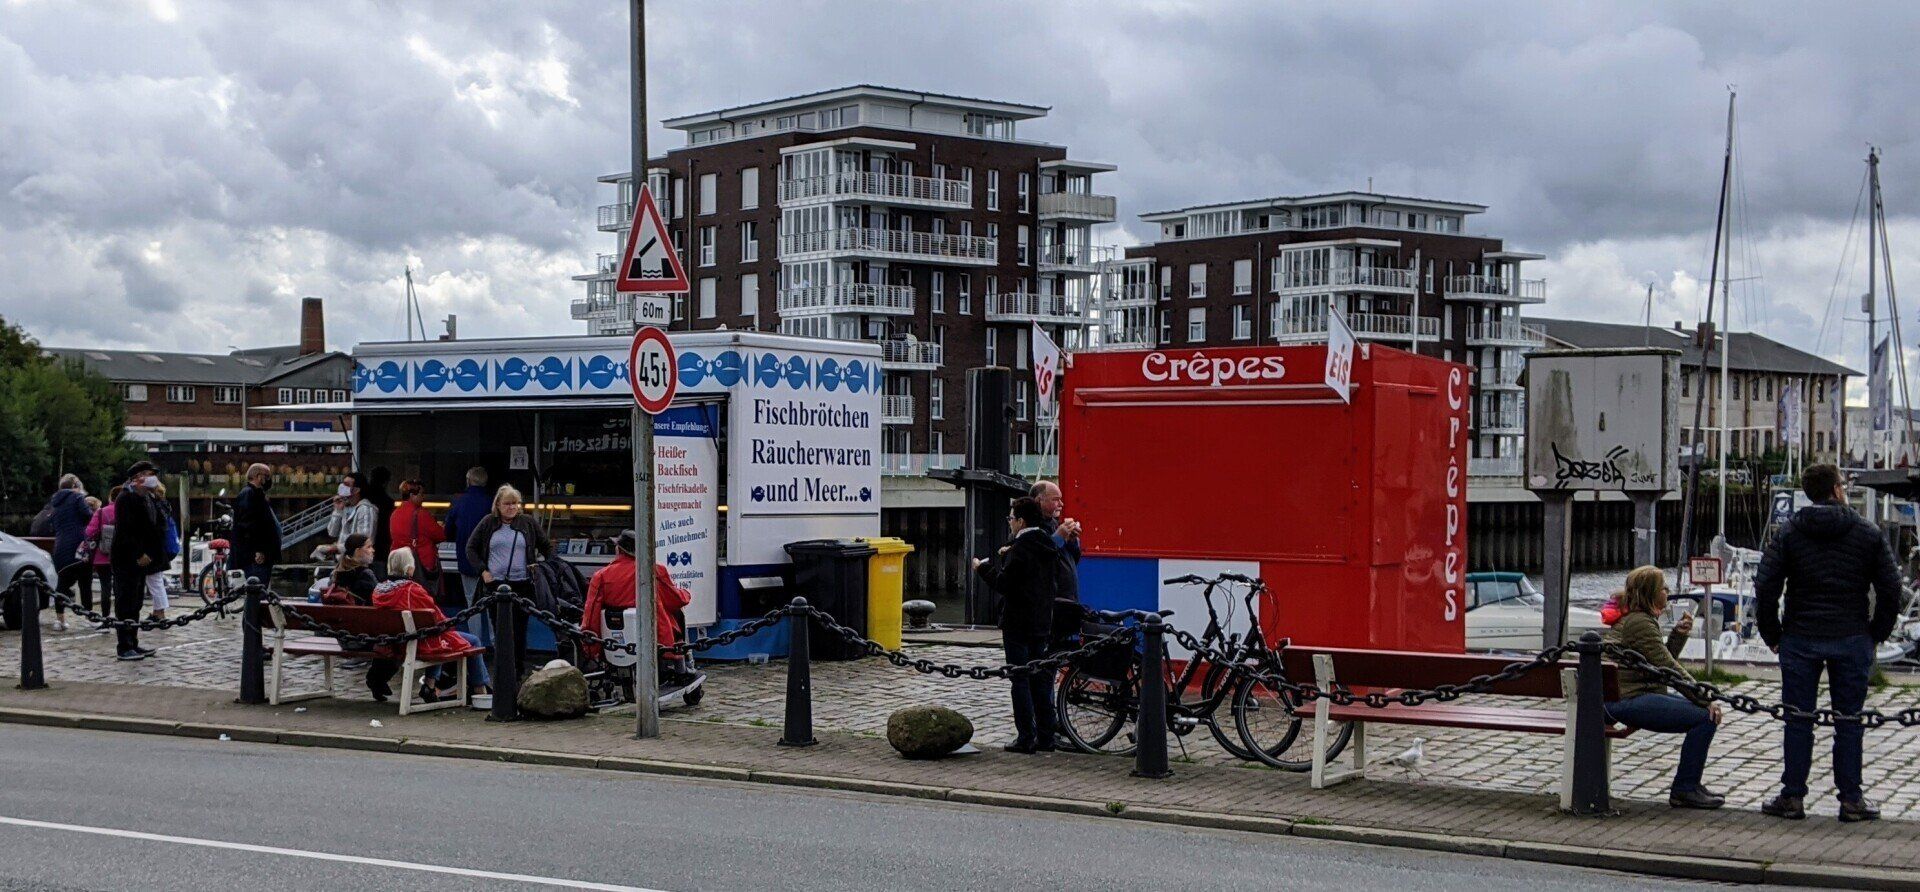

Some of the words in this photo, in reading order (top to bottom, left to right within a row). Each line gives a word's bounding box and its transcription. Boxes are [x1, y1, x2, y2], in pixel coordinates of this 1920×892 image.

[642, 301, 664, 319] 60m
[1142, 352, 1286, 387] Crêpes
[753, 398, 869, 428] Fischbrötchen
[653, 422, 670, 430] nsere
[658, 445, 687, 459] Heißer
[751, 438, 871, 466] Räucherwaren
[657, 463, 698, 477] Backfisch
[657, 483, 708, 494] Fischfrikadelle
[766, 477, 798, 502] und
[804, 477, 858, 502] Meer...
[1444, 367, 1462, 622] Crêpes
[657, 500, 702, 512] hausgemacht
[660, 519, 677, 532] Alles
[677, 516, 694, 528] auch
[655, 540, 666, 549] um
[667, 528, 708, 546] Mitnehmen!
[670, 570, 704, 581] spezialitäten
[679, 580, 692, 589] 1967
